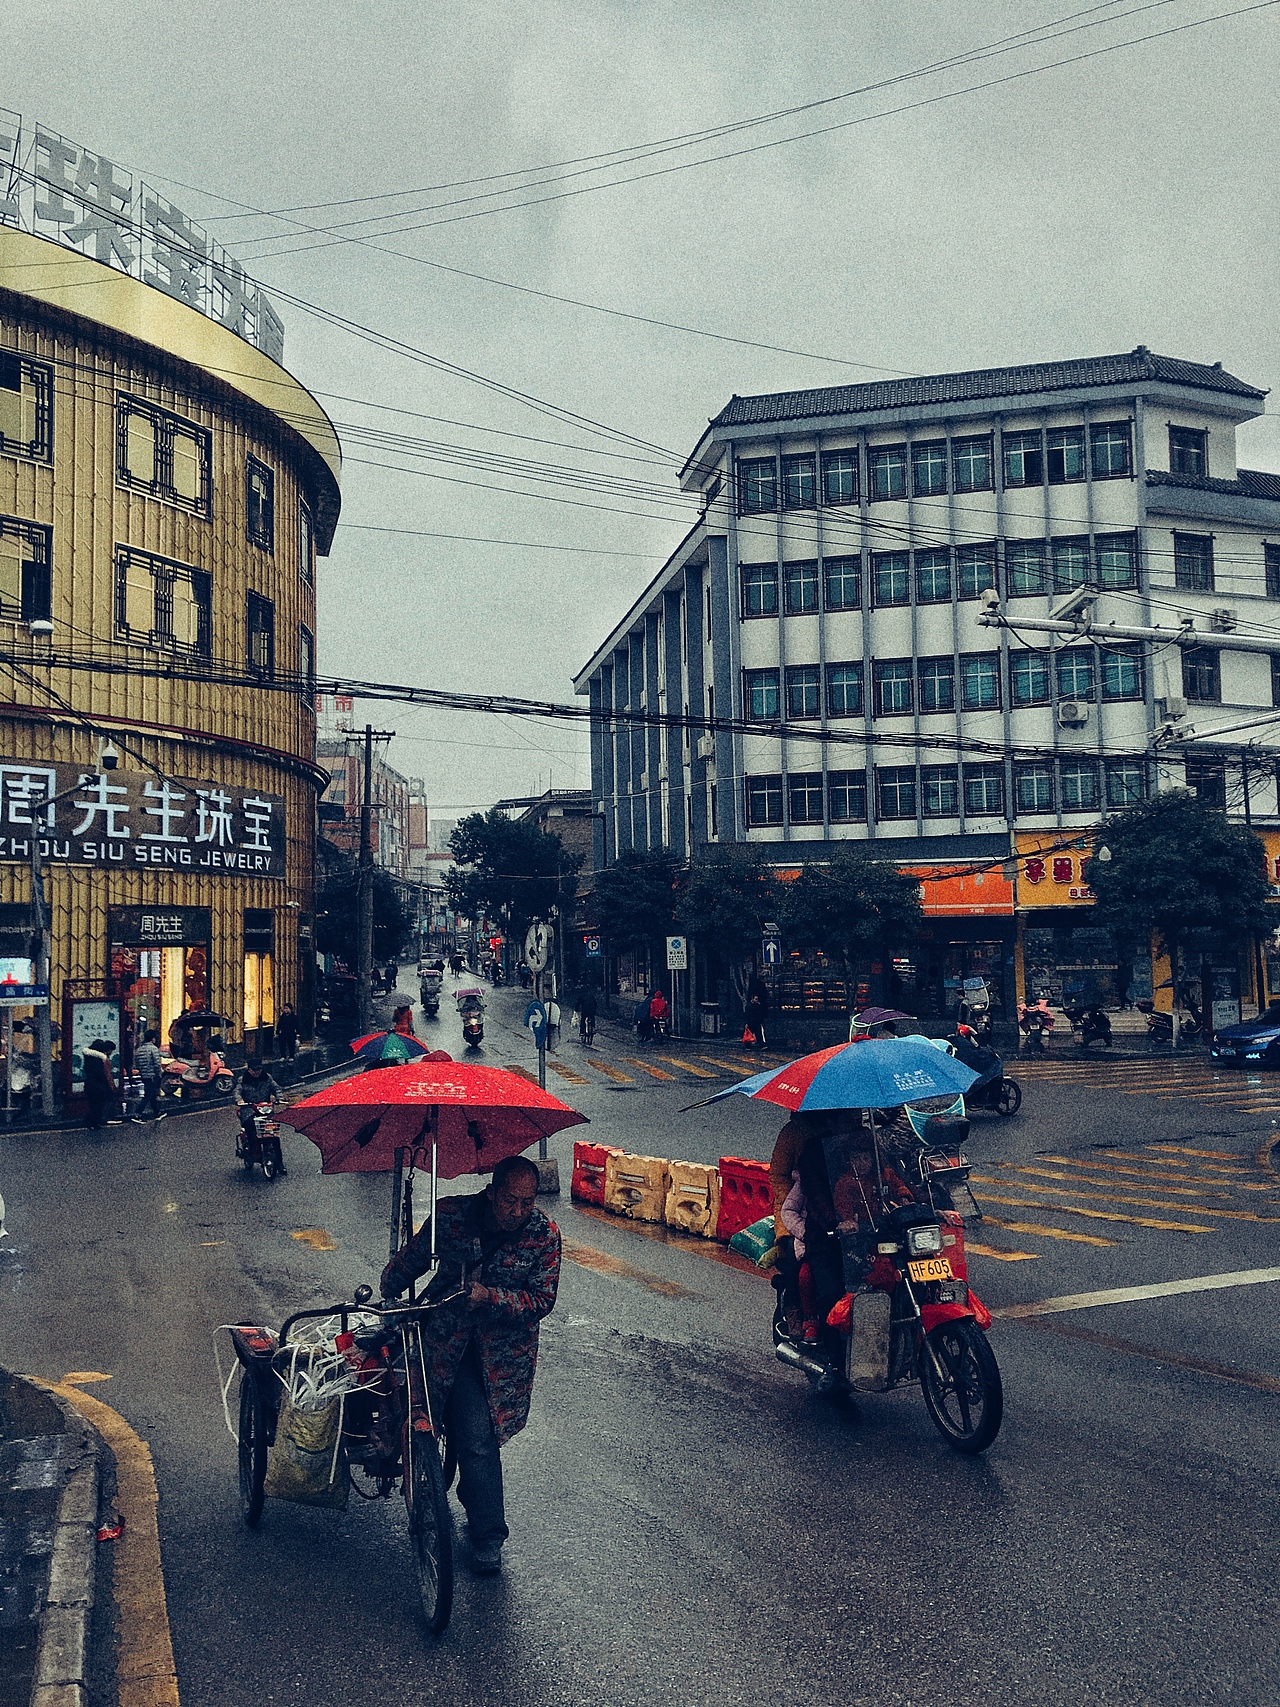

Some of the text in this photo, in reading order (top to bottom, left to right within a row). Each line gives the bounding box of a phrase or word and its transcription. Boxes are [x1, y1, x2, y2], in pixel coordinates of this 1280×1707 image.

[0, 764, 272, 852] 周先生珠宝
[0, 837, 271, 872] ZHOU SIU SENG JEWELRY
[140, 915, 183, 933] 周先生
[910, 1259, 950, 1278] HF605
